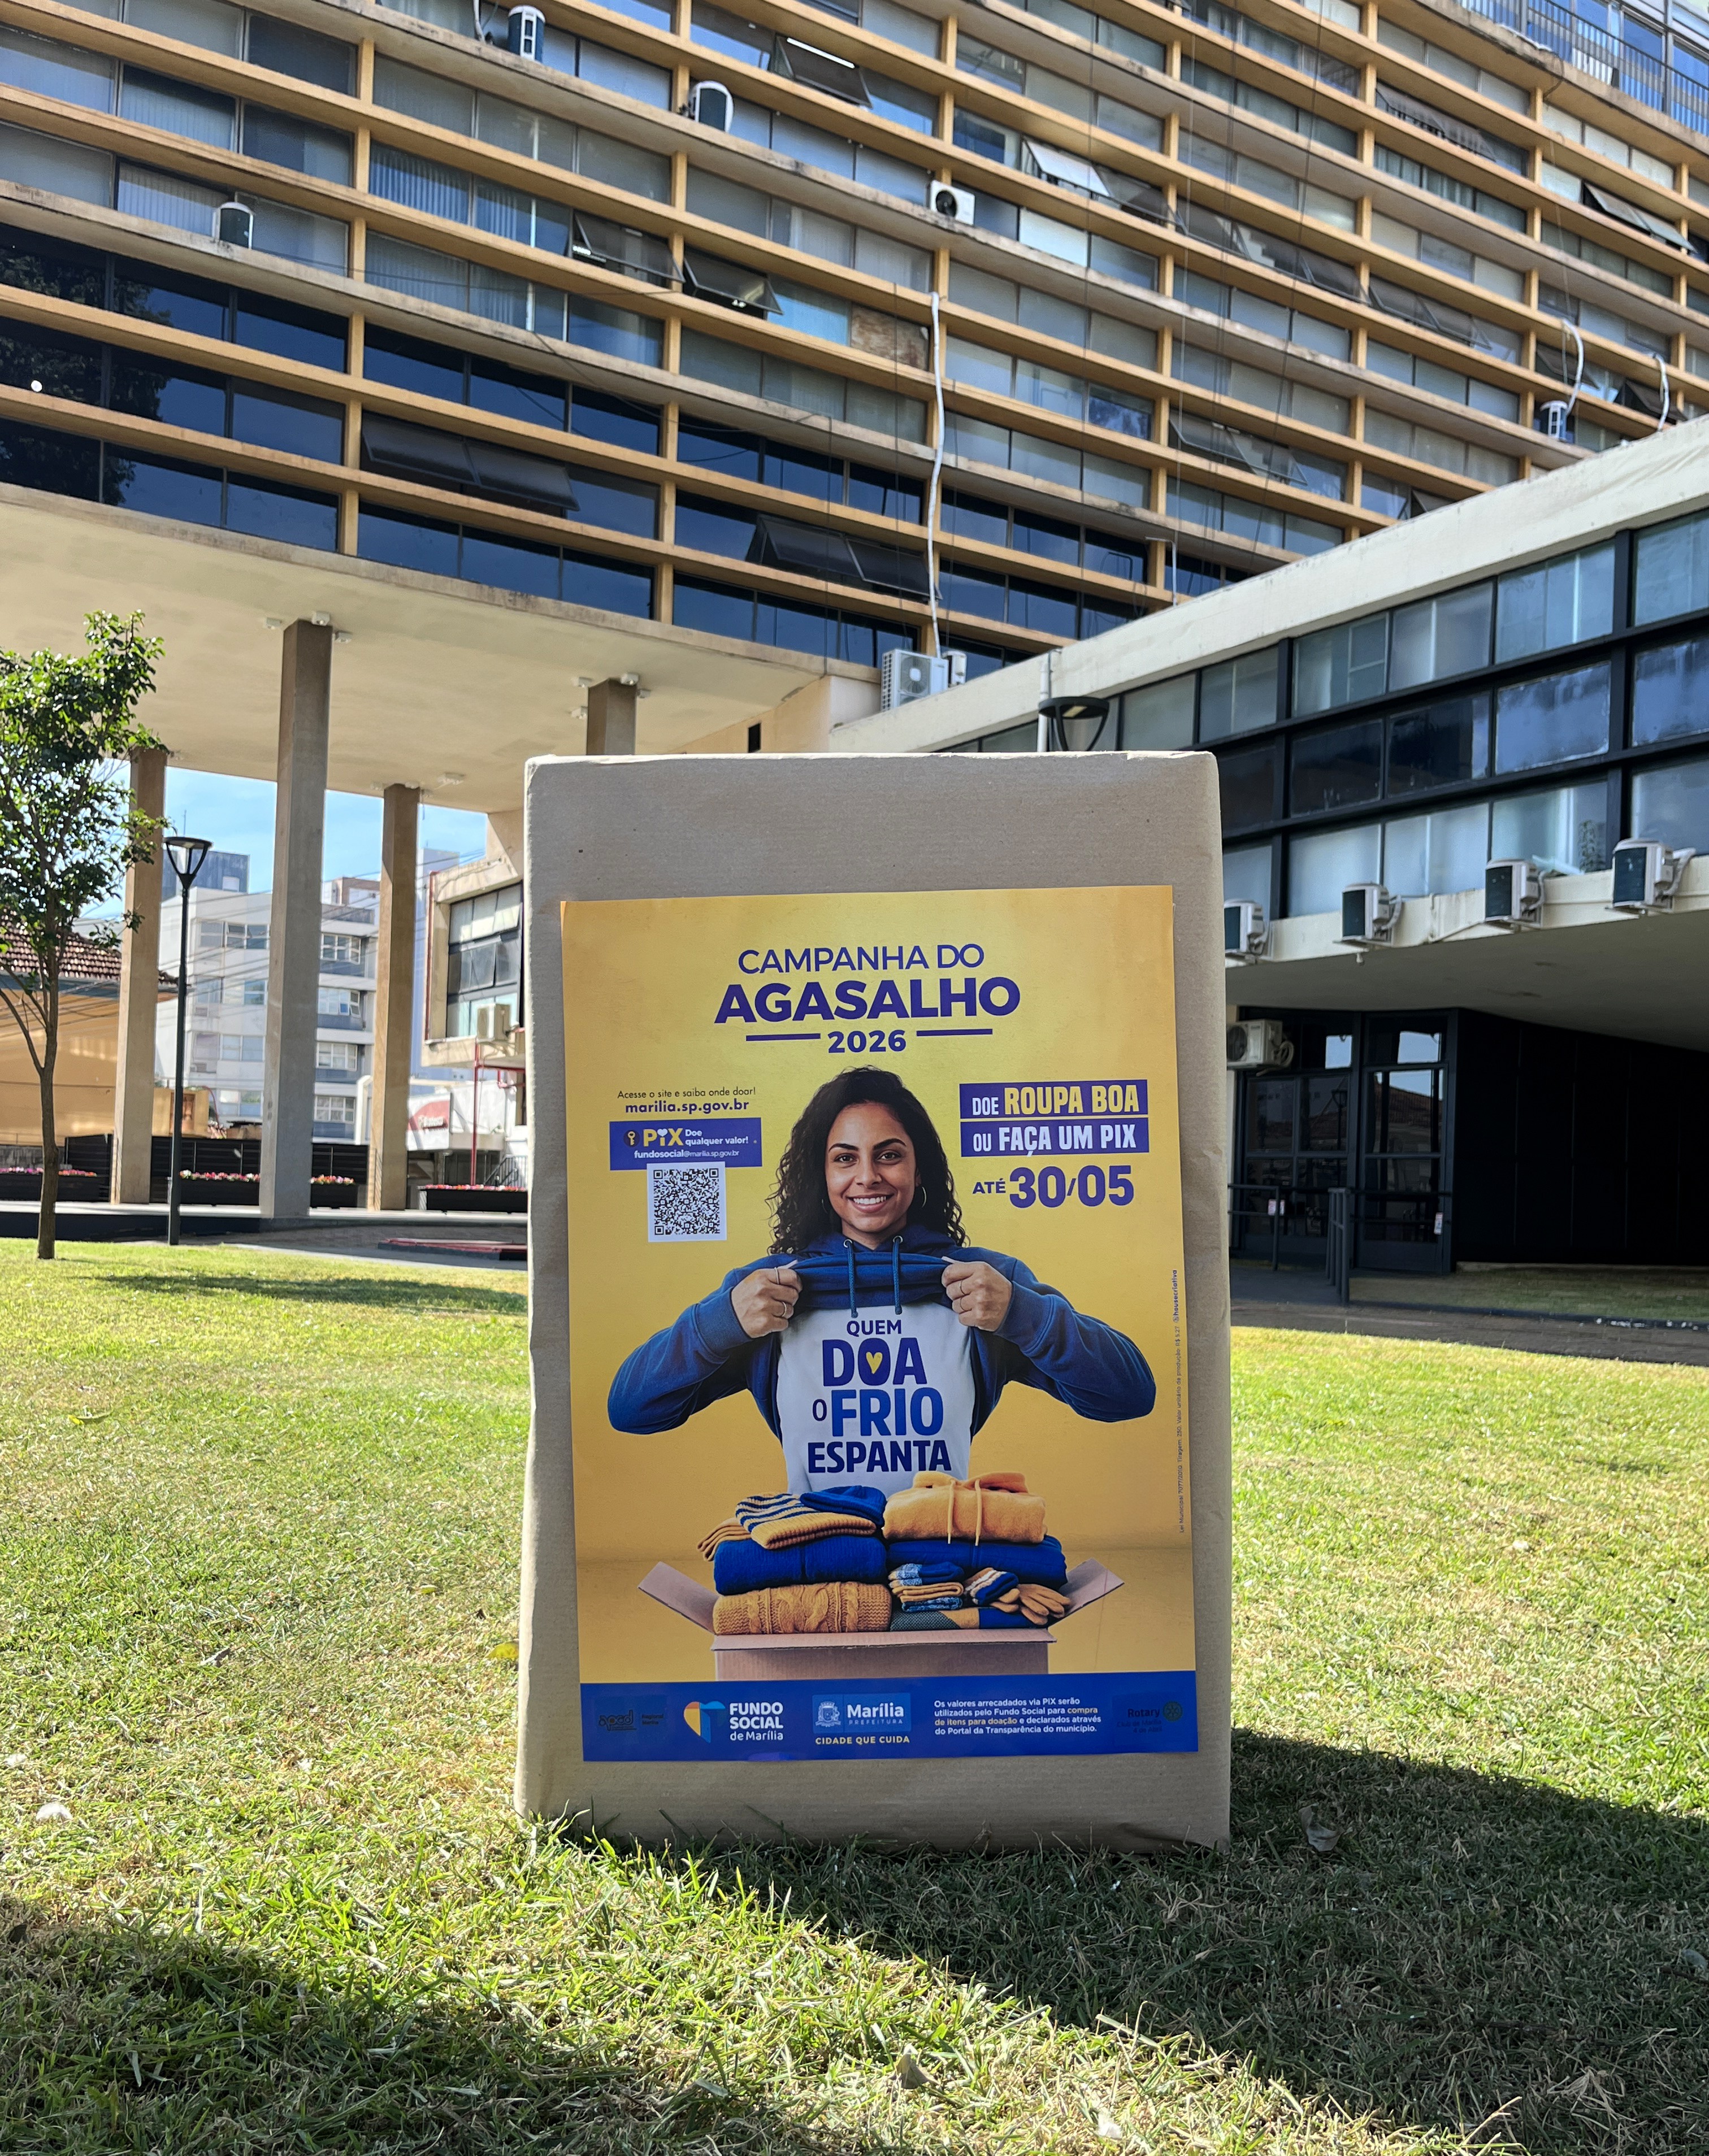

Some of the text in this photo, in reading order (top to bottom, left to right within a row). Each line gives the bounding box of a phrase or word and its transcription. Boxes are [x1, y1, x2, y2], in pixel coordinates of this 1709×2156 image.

[739, 944, 984, 974] CAMPANHA DO
[714, 976, 1021, 1023] AGASALHO
[827, 1029, 906, 1053] 2026
[617, 1090, 647, 1099] Acesse
[683, 1087, 705, 1097] saiba
[709, 1086, 730, 1096] onde
[733, 1086, 756, 1096] doar!
[972, 1085, 1139, 1115] DOE ROUPA BOA
[626, 1098, 749, 1114] marilia.sp.gov.br
[685, 1136, 748, 1146] qualquer valor!
[973, 1124, 1137, 1157] OU FAÇA UM PIX
[973, 1164, 1134, 1208] ATÉ 30/05
[847, 1319, 901, 1337] QUEM
[822, 1337, 927, 1386] DOA
[812, 1387, 943, 1437] O FRIO
[808, 1440, 952, 1473] ESPANTA
[730, 1702, 783, 1715] FUNDO
[847, 1702, 904, 1718] Marília
[974, 1709, 992, 1717] pelo
[1127, 1709, 1160, 1718] Rotary
[730, 1716, 784, 1729] SOCIAL
[986, 1725, 1041, 1734] Transparência
[1056, 1724, 1097, 1733] município.
[730, 1730, 783, 1741] de Marília
[856, 1736, 876, 1745] QUE
